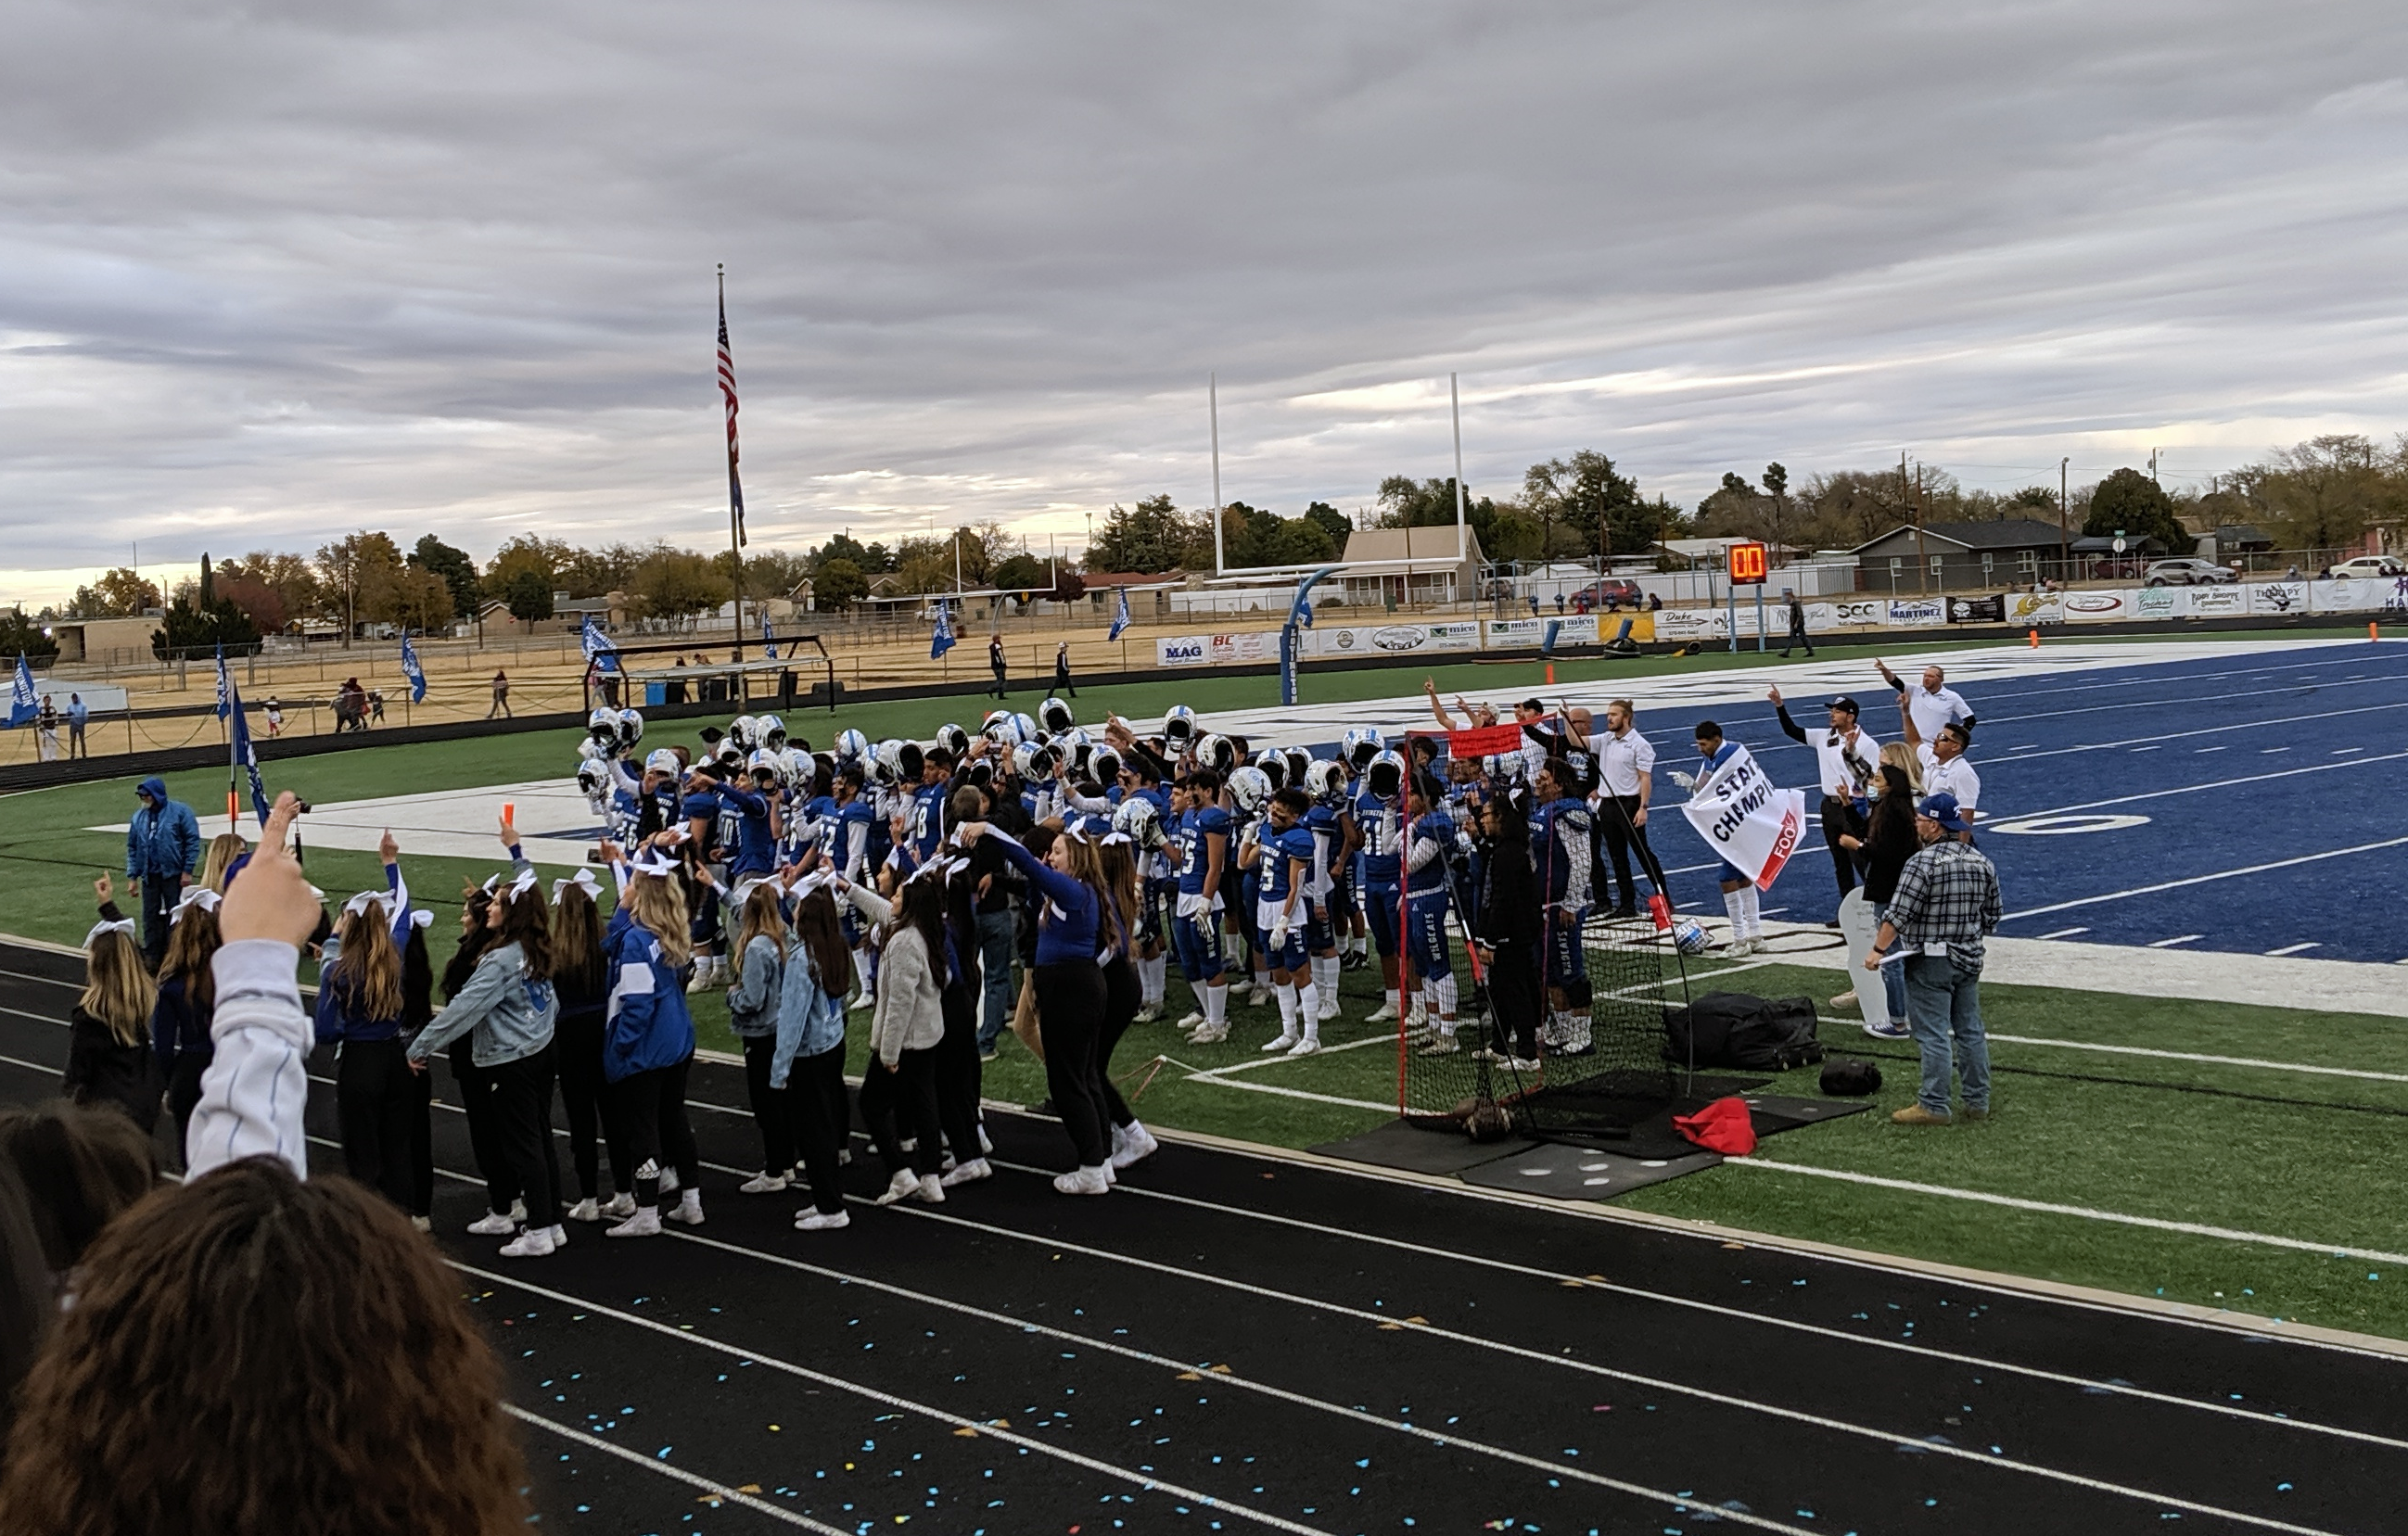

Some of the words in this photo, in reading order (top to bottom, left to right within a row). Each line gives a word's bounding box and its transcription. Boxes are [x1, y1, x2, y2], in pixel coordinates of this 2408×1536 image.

[1733, 547, 1763, 578] 00
[2386, 598, 2408, 607] HA
[1665, 612, 1692, 621] Duke
[1837, 603, 1875, 618] SCC
[1890, 608, 1942, 619] MARTINEZ
[1449, 624, 1476, 633] mico
[1213, 635, 1234, 646] BC
[1166, 647, 1203, 658] MAG
[1289, 628, 1298, 705] LOVINGTON
[1716, 756, 1760, 803] STAT
[1774, 825, 1797, 859] FOO
[1424, 912, 1442, 962] WILDCATS
